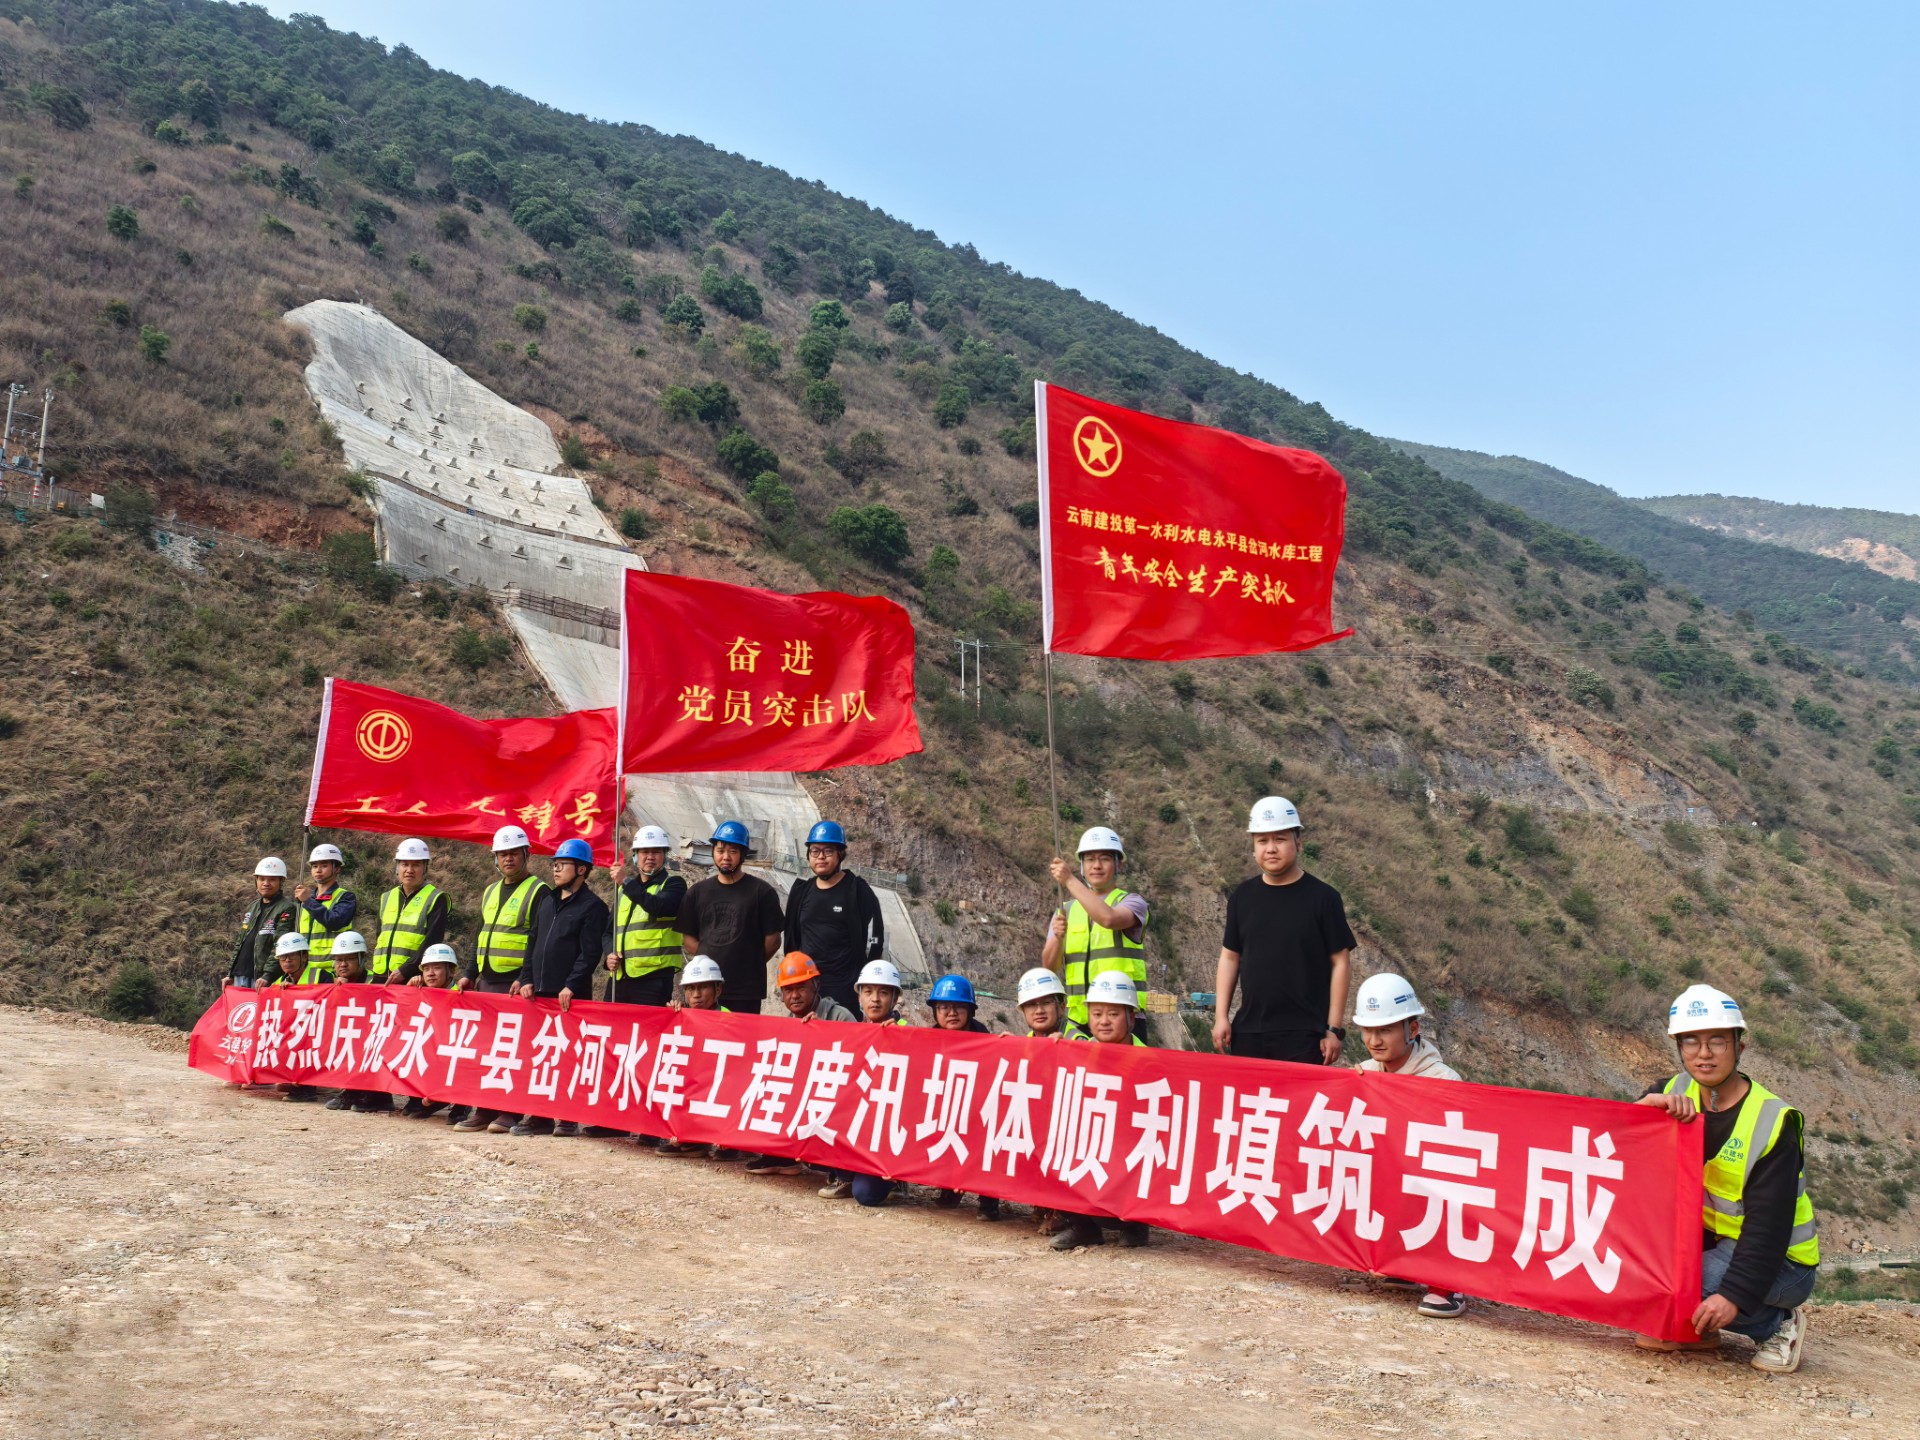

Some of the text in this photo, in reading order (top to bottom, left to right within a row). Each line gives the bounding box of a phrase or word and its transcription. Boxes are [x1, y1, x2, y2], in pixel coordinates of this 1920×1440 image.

[1066, 506, 1323, 562] 云南建投第一水利水电永平县岔河水库工程
[1094, 546, 1296, 606] 青年安全生产突击队
[725, 636, 814, 675] 奋进
[677, 685, 877, 727] 党员突击队
[252, 997, 1624, 1294] 热烈庆祝永平县岔河水库工程度汛坝体顺利填筑完成
